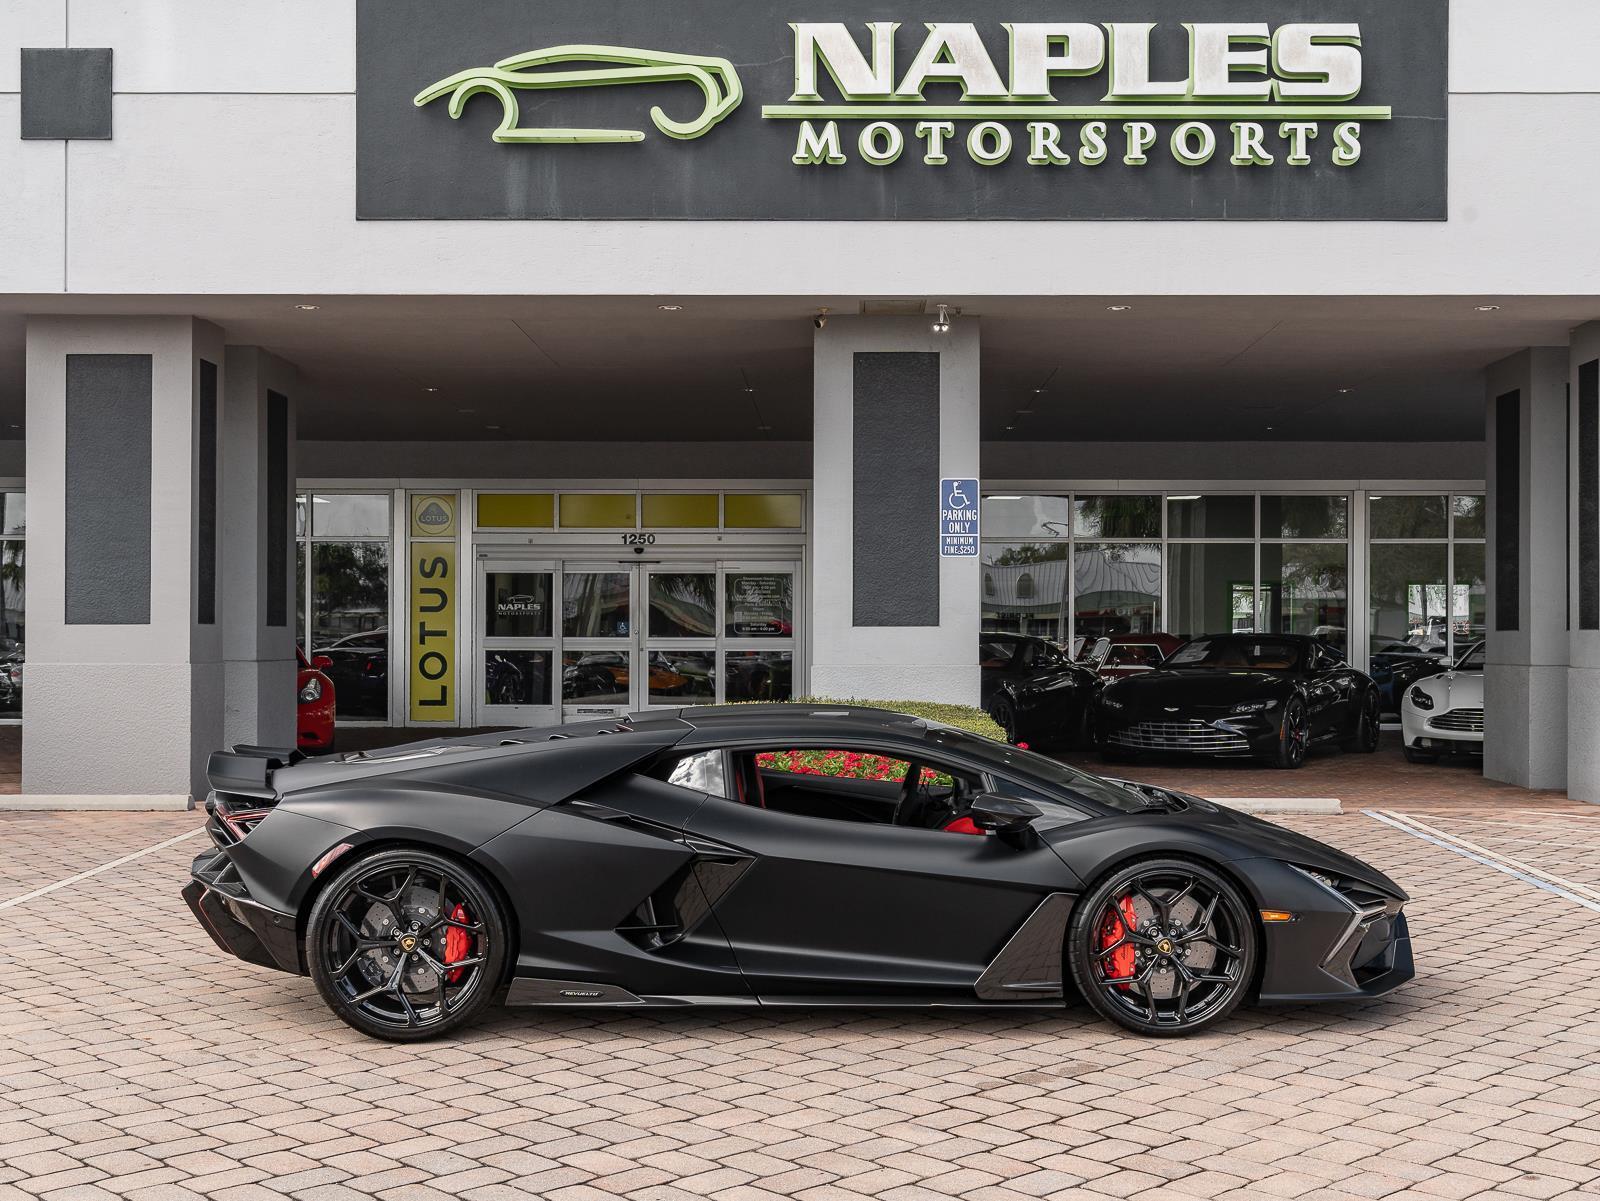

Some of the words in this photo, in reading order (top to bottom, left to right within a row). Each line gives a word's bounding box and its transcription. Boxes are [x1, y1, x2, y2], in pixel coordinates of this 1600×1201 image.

[787, 22, 1362, 102] NAPLES
[792, 120, 1361, 166] MOTORSPORTS
[942, 510, 977, 521] PARKING
[949, 522, 971, 533] ONLY
[621, 533, 656, 545] 1250
[946, 537, 973, 545] MINIMUM
[944, 546, 959, 554] FINE
[960, 546, 975, 554] $250
[418, 556, 448, 706] LOTUS
